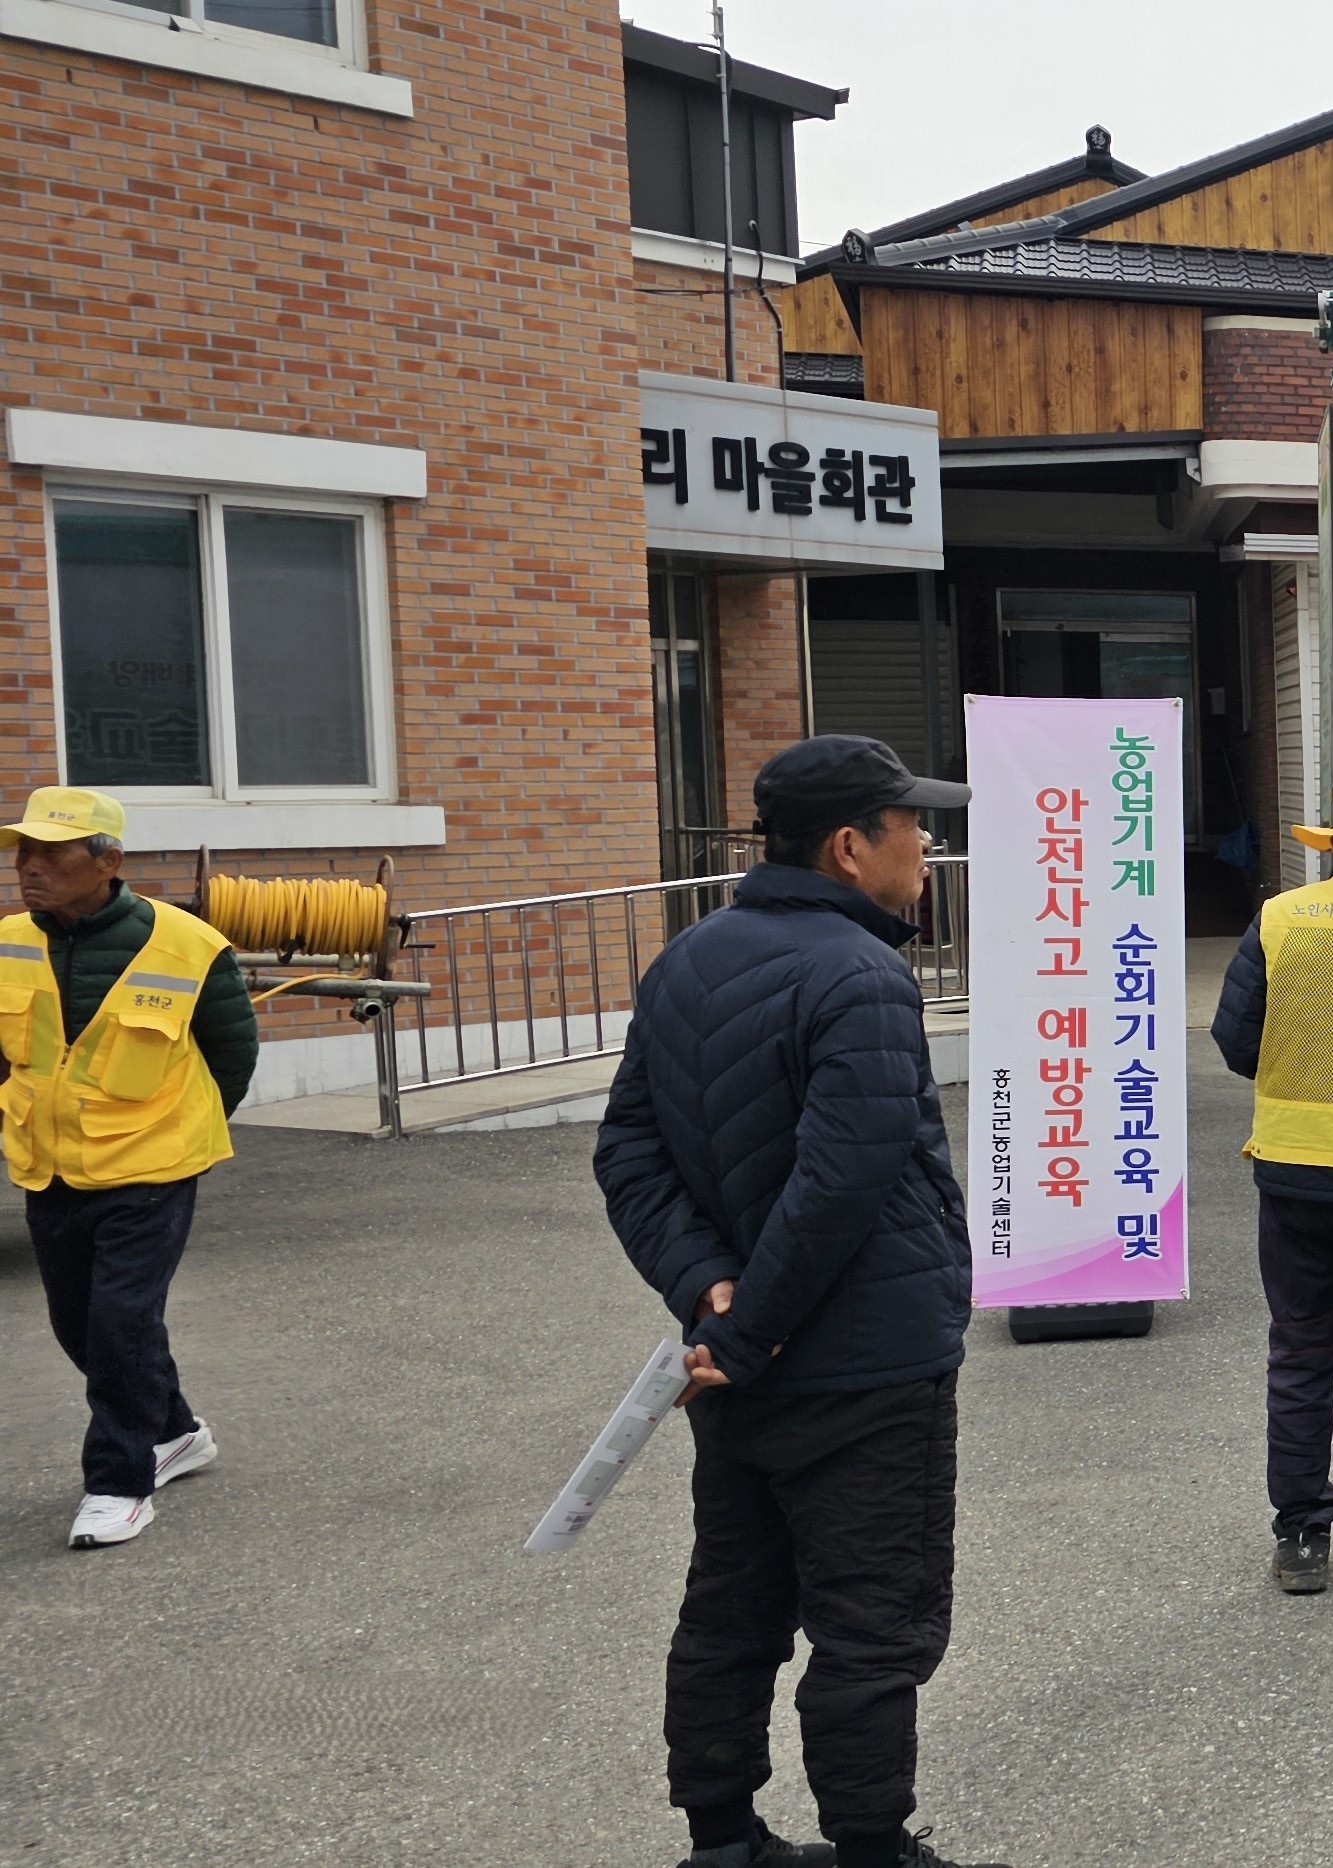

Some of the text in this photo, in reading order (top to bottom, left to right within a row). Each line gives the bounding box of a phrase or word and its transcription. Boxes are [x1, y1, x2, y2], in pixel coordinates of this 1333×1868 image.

[712, 436, 915, 524] 마을회관
[133, 994, 172, 1010] 홍천군
[1035, 786, 1092, 1208] 안전사고 예방교육
[1109, 726, 1161, 1260] 농업기계 순회기술교육 및
[991, 1068, 1012, 1259] 홍천군농업기술센터
